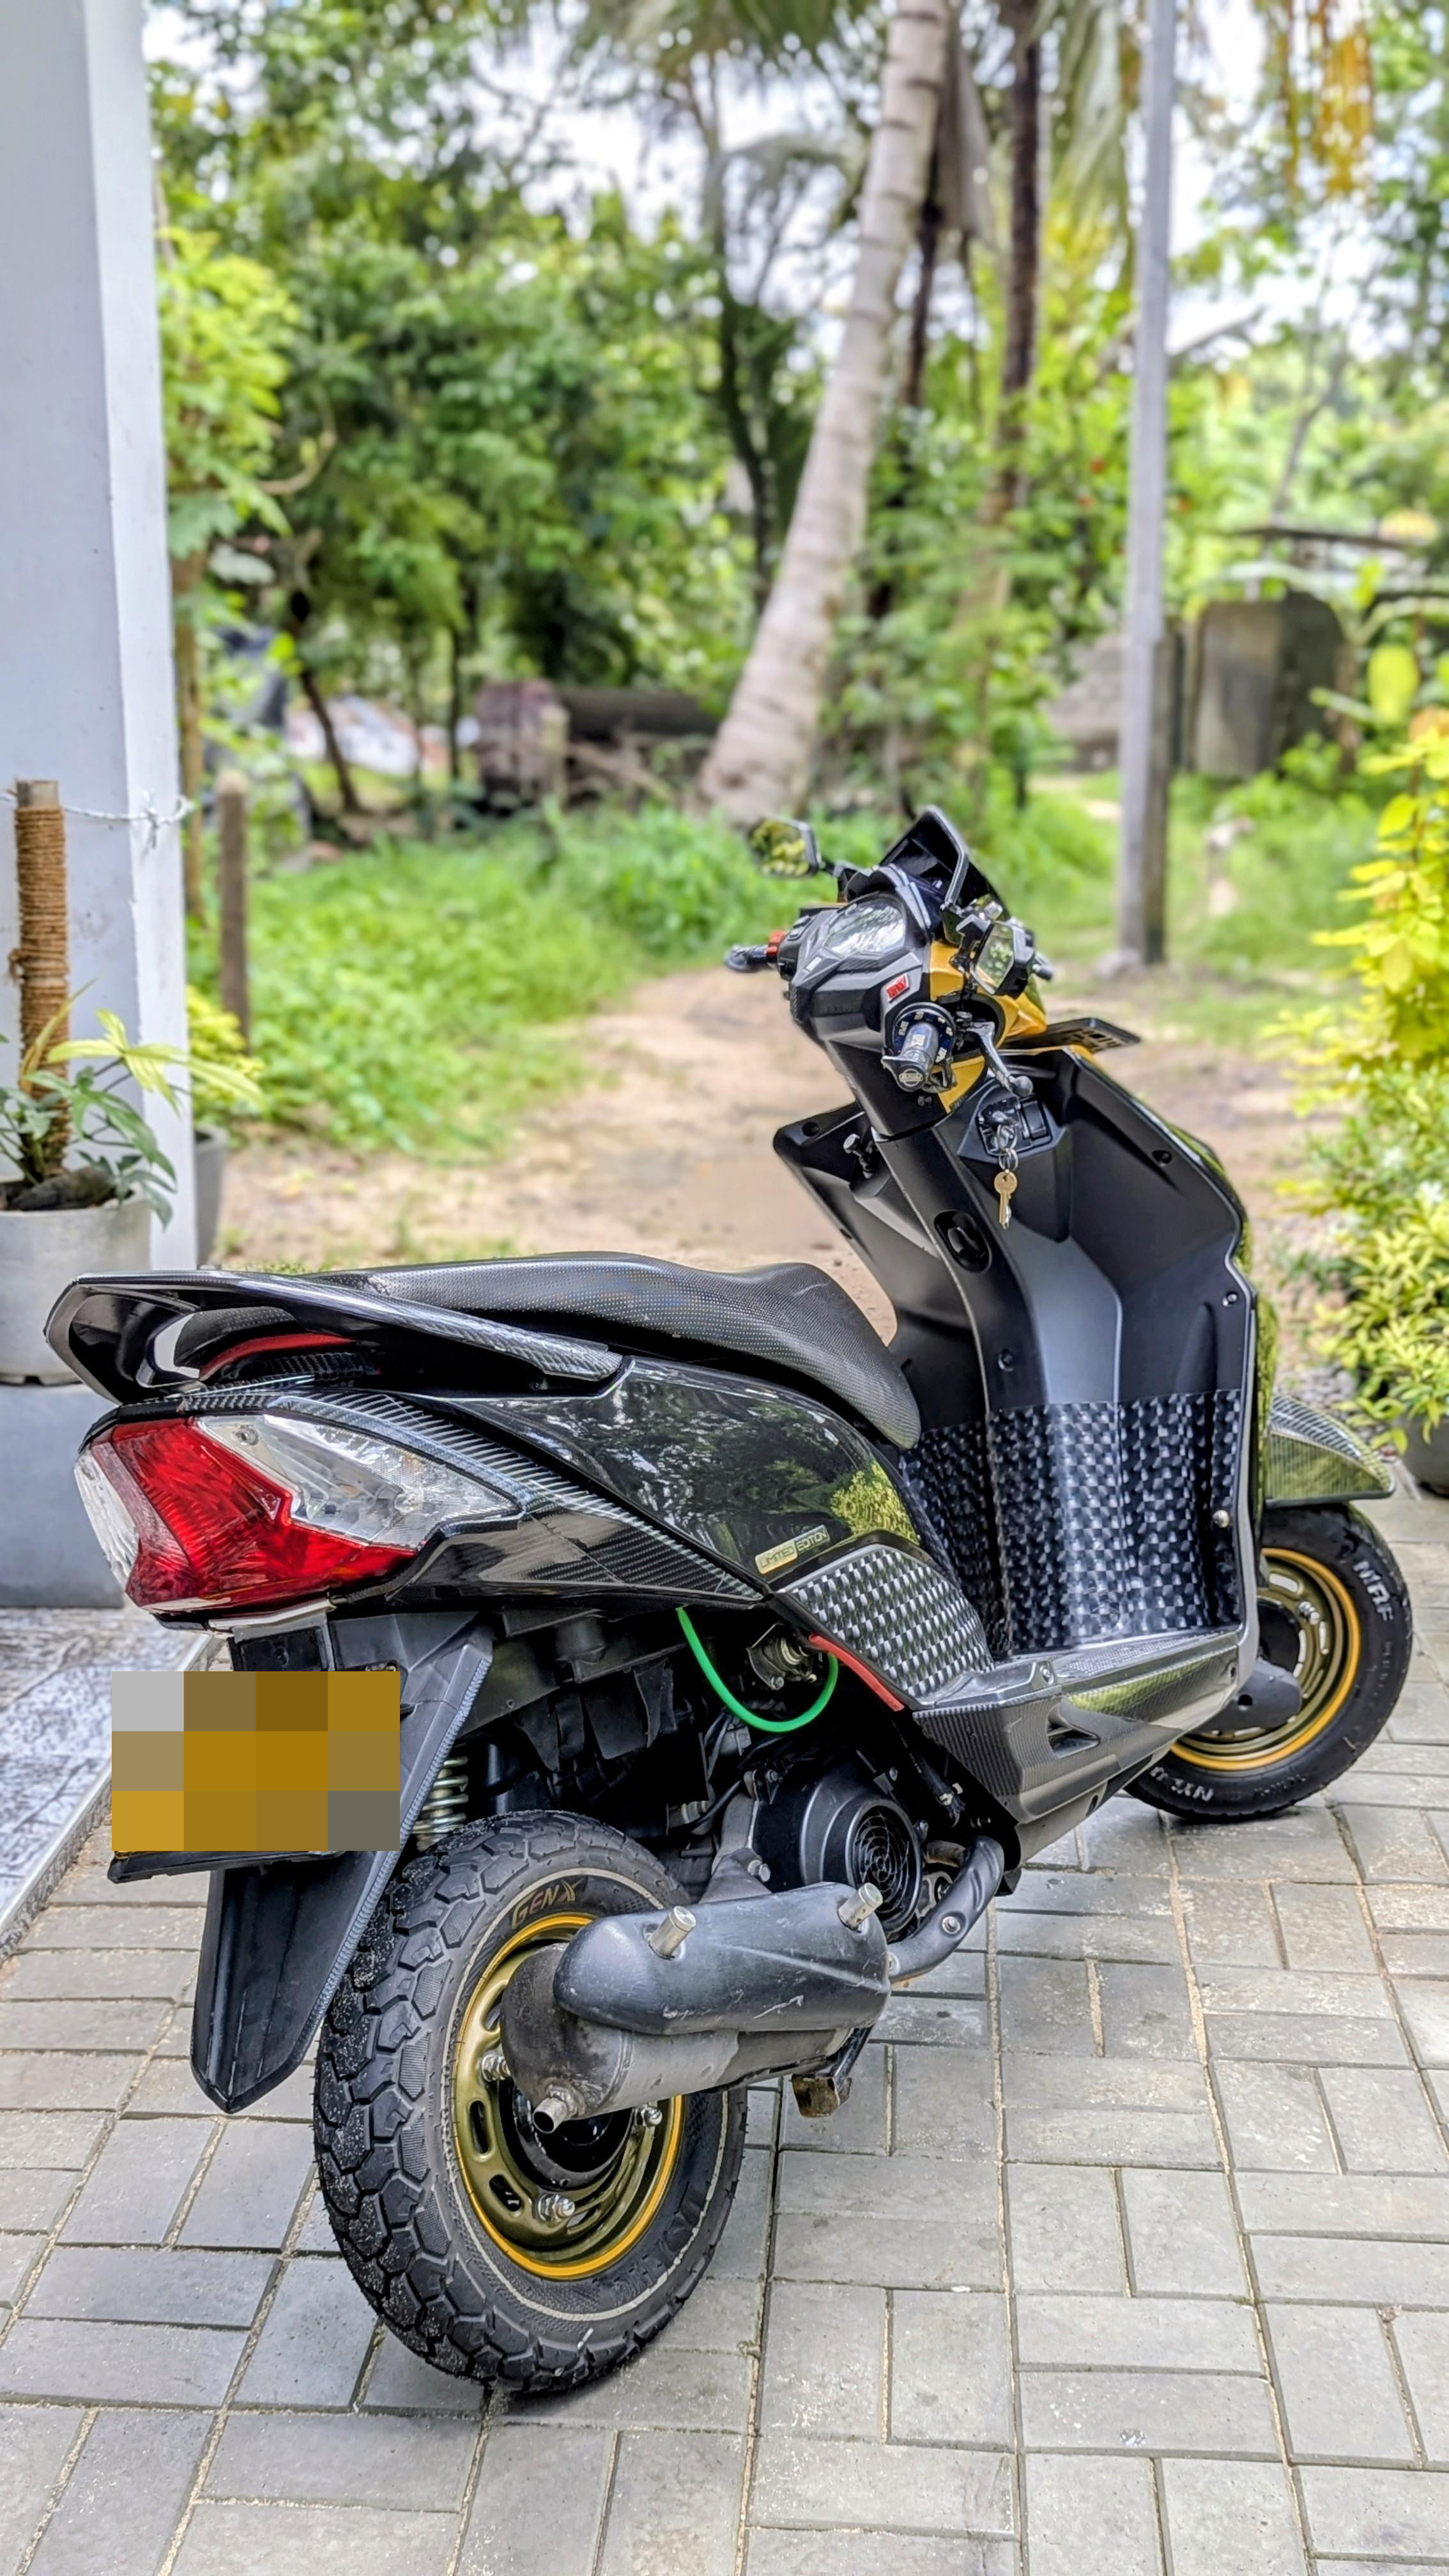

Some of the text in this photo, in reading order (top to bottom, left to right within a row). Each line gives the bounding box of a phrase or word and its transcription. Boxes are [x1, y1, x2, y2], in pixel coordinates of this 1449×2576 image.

[758, 1531, 828, 1568] LIMITED EDITION
[1353, 1559, 1393, 1622] MRF
